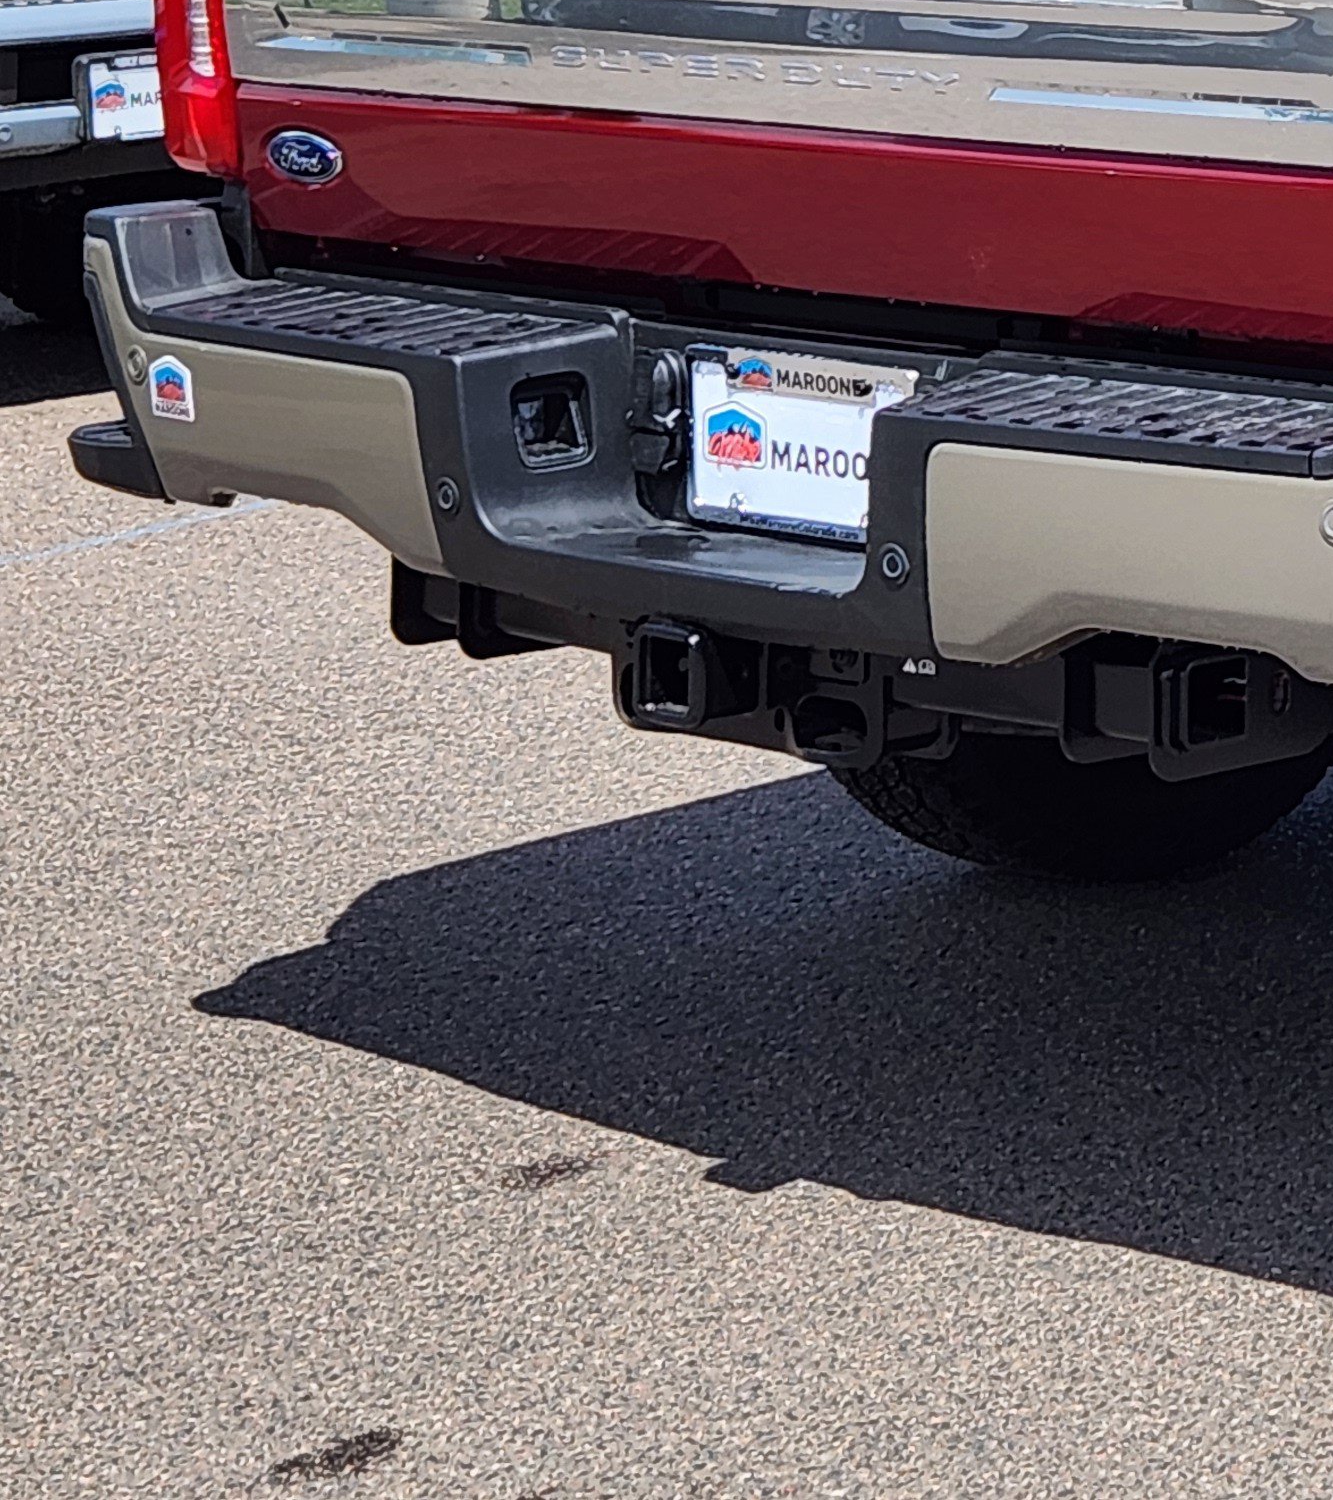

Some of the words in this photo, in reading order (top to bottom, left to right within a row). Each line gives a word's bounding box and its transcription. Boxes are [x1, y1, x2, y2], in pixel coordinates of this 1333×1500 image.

[550, 45, 766, 82] SUPER
[780, 62, 960, 95] DUTY
[281, 141, 322, 173] Ford
[776, 368, 874, 397] MAROONE
